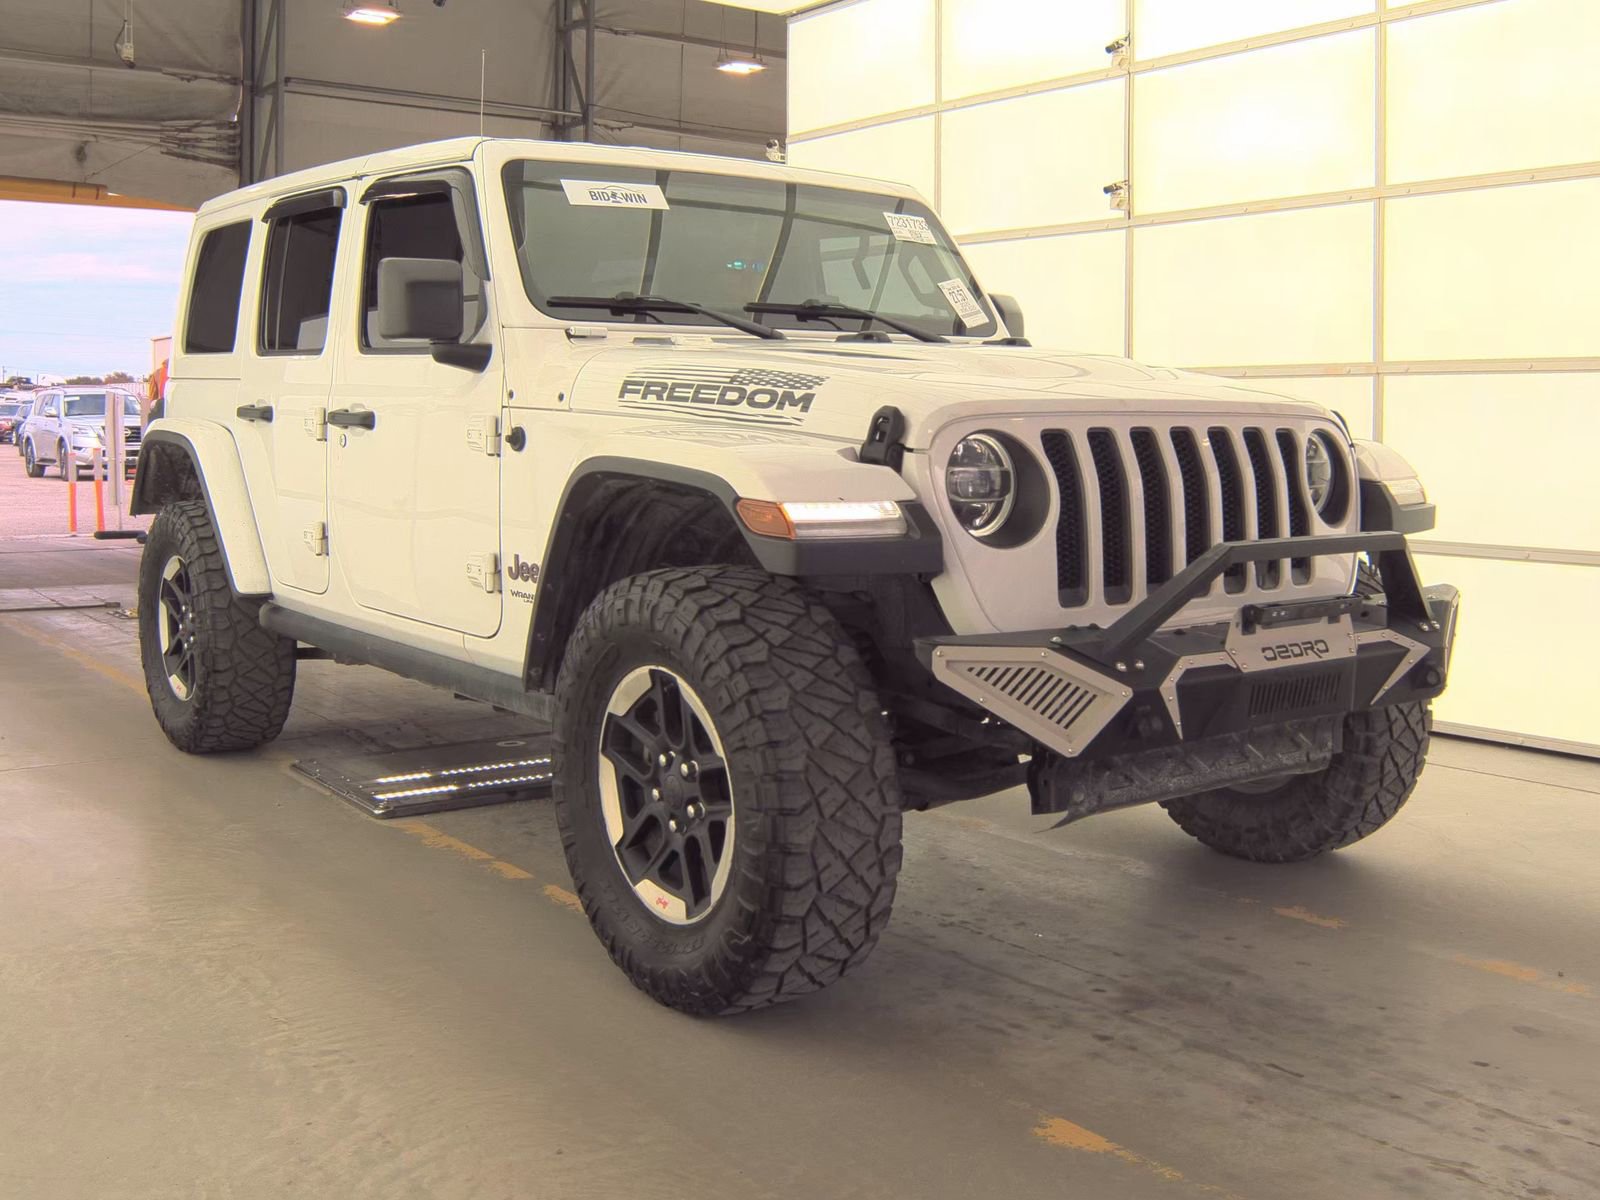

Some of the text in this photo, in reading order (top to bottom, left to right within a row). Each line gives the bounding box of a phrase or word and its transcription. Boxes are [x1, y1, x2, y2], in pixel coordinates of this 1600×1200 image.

[589, 191, 648, 204] BID WIN
[618, 380, 816, 412] FREEDOM
[507, 554, 540, 584] Jee
[511, 589, 535, 600] WRAN
